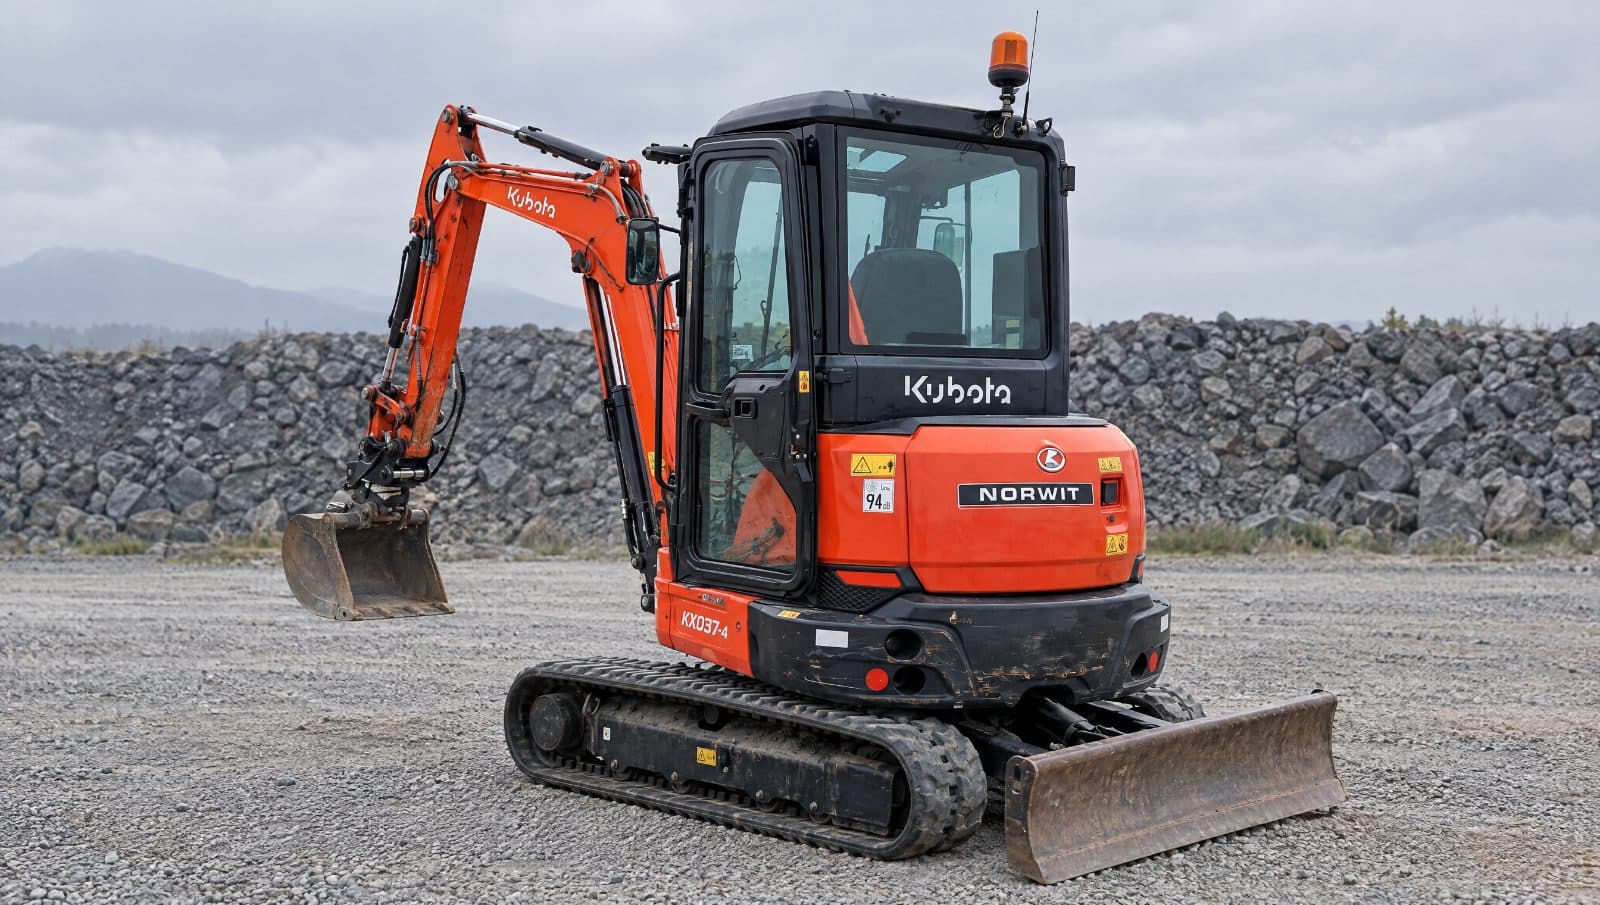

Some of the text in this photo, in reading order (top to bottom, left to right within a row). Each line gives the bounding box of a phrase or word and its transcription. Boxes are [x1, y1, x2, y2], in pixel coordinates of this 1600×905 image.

[507, 186, 556, 219] Kubota
[904, 375, 1011, 404] Kubota
[866, 493, 882, 510] 94
[979, 487, 1080, 502] NORWIT
[681, 610, 728, 639] KX037-4
